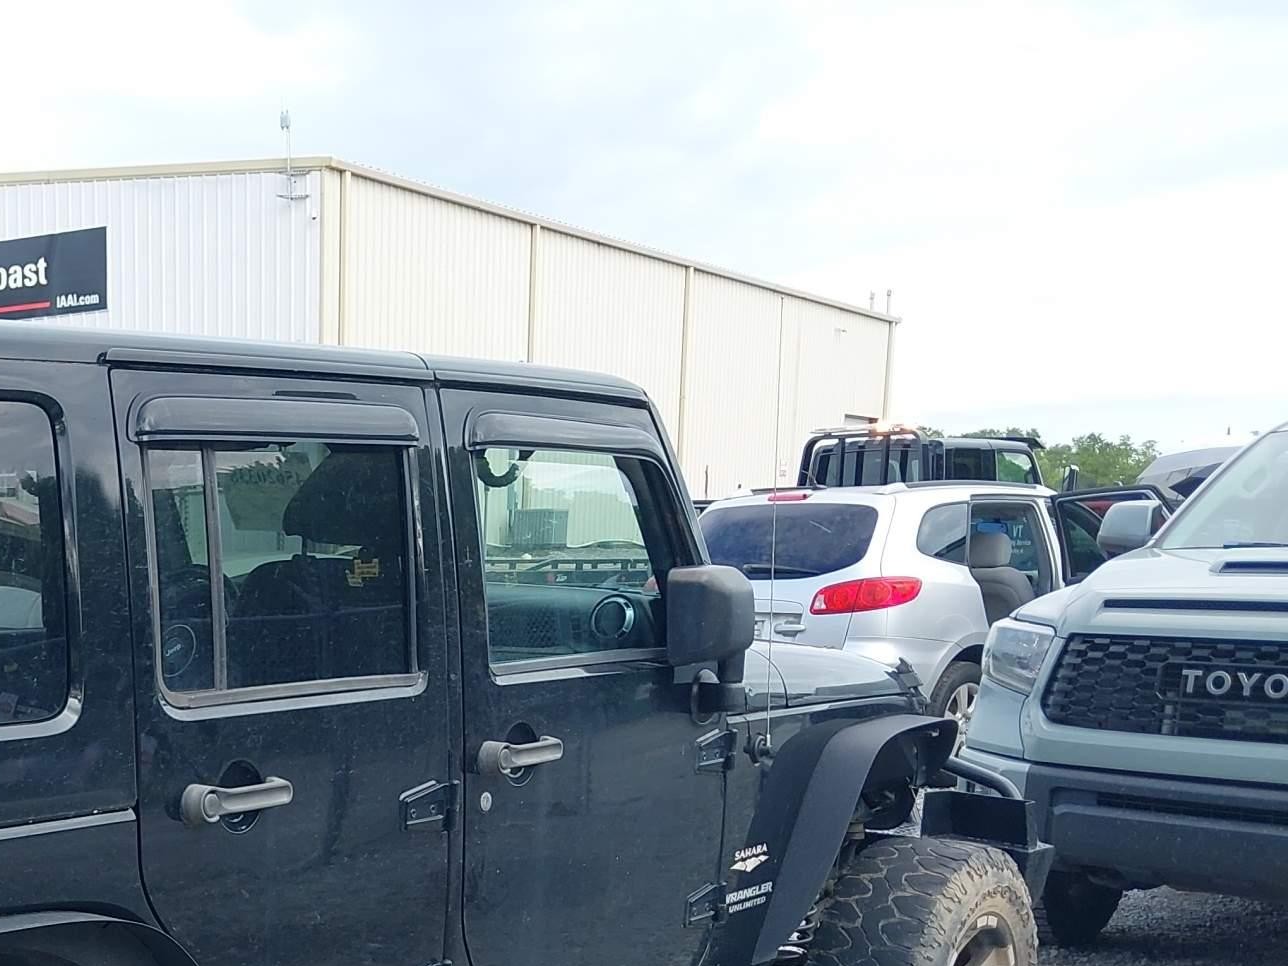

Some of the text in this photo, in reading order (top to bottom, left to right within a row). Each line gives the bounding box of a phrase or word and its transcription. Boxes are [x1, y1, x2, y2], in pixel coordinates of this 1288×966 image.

[1182, 669, 1288, 700] TOYO
[734, 842, 768, 861] SAHARA
[728, 896, 766, 913] UNLIMITED
